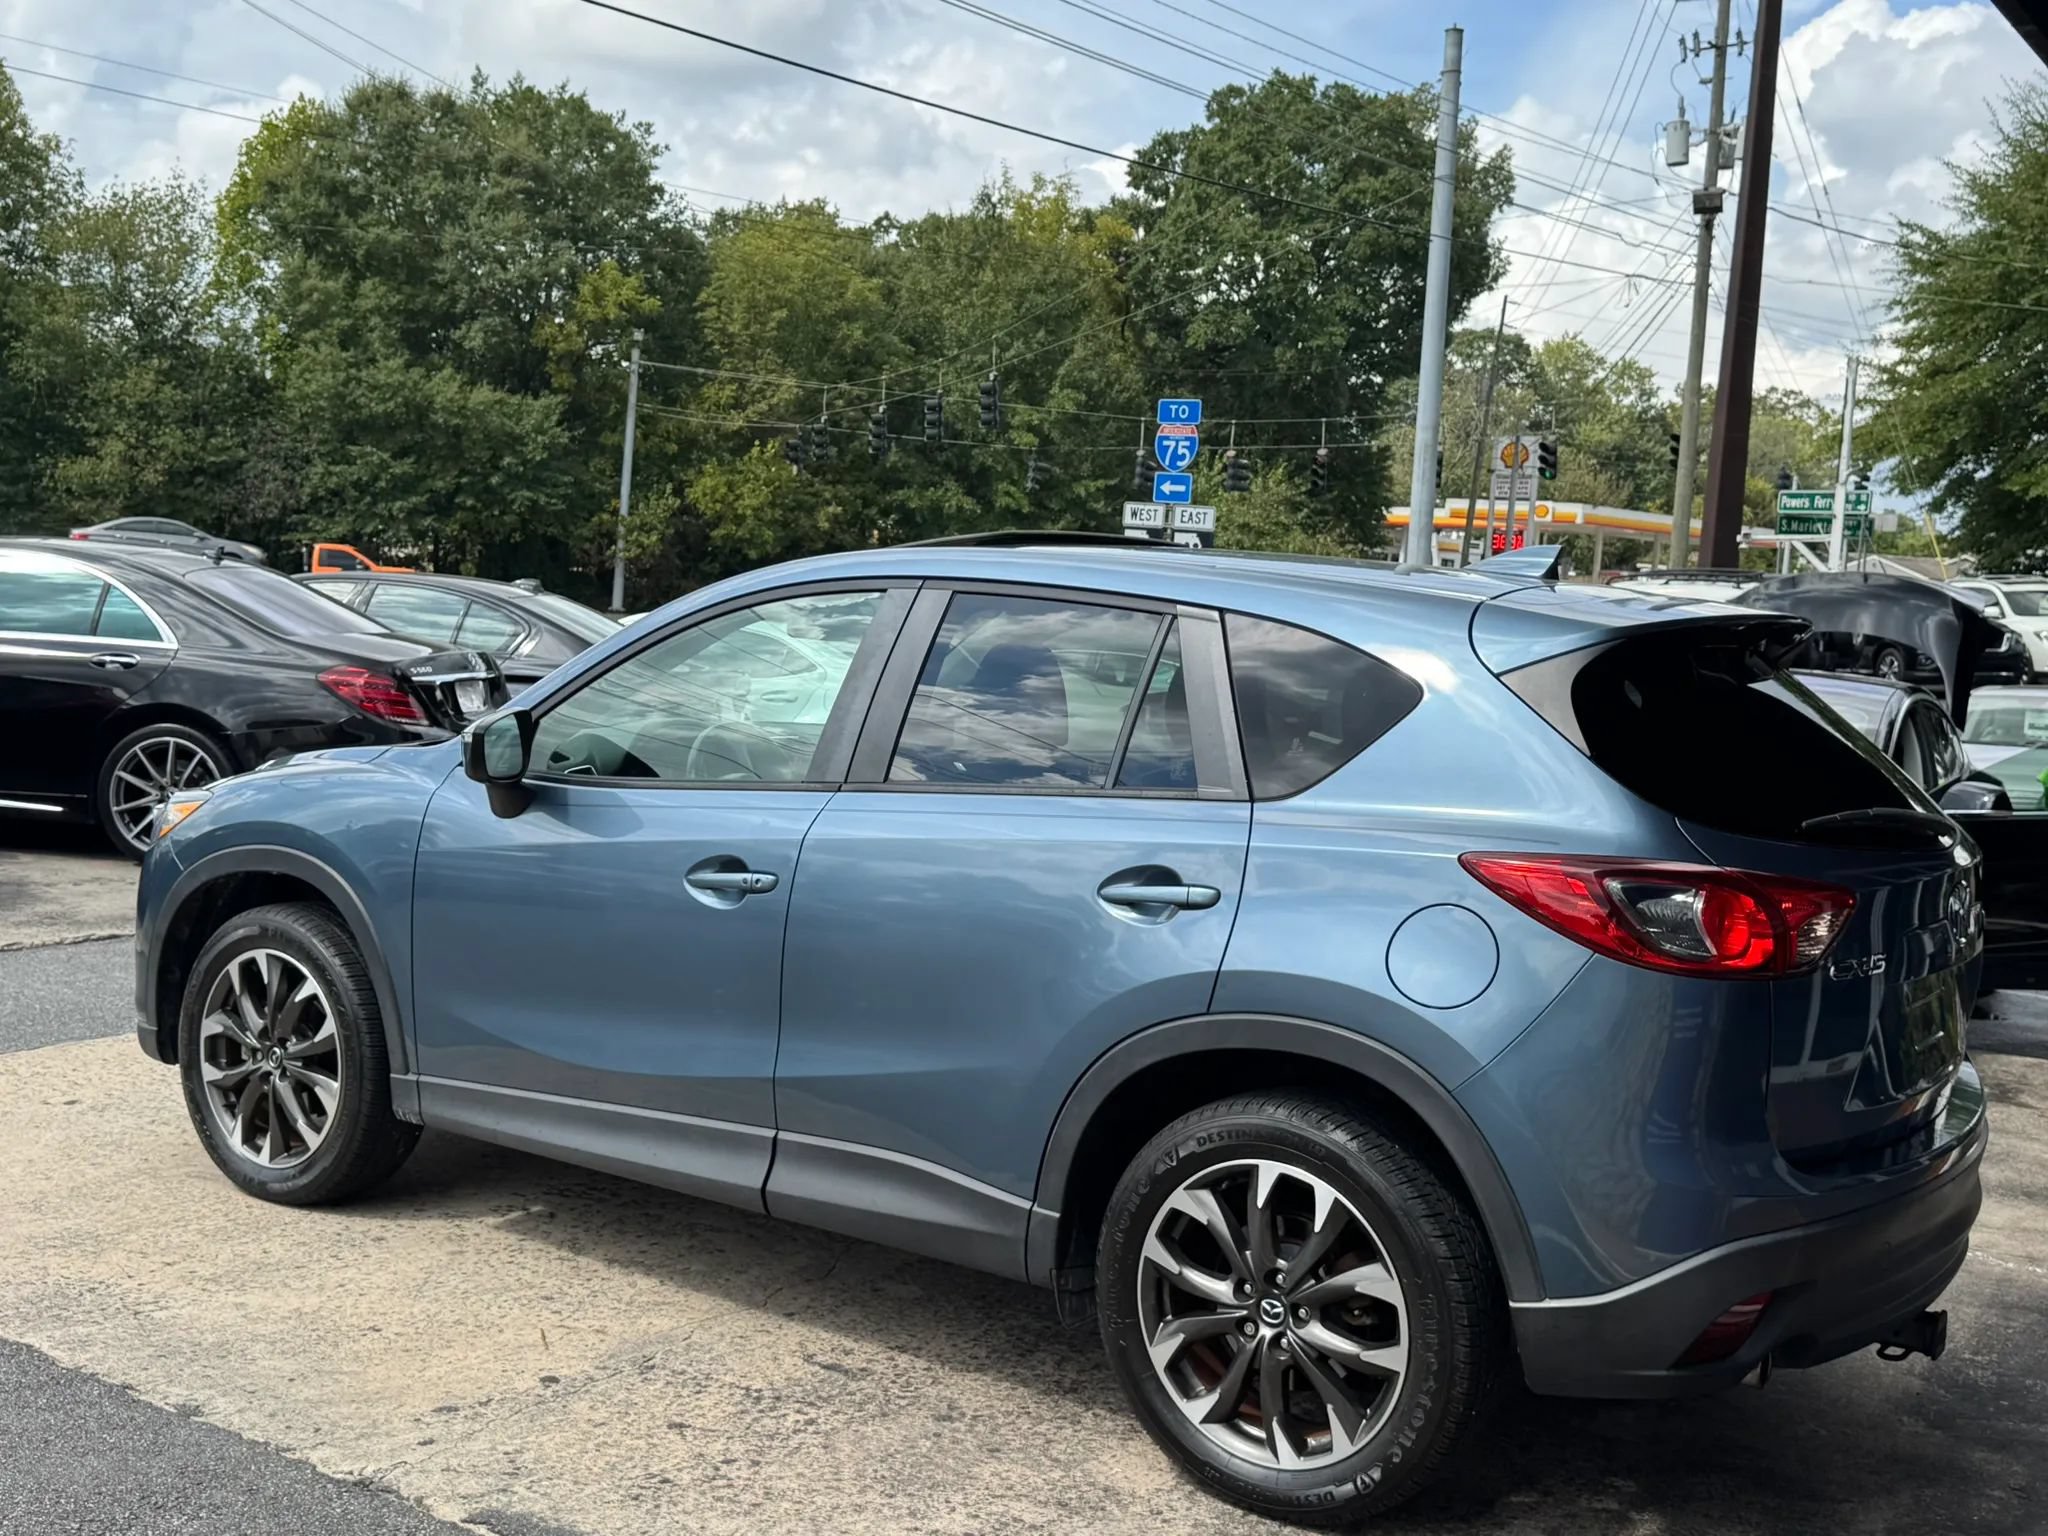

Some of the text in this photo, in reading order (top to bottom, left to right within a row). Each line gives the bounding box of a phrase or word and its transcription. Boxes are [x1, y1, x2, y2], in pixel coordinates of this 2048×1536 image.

[1169, 405, 1189, 419] TO
[1162, 440, 1190, 467] 75
[1130, 507, 1158, 522] WEST
[1180, 510, 1208, 525] EAST
